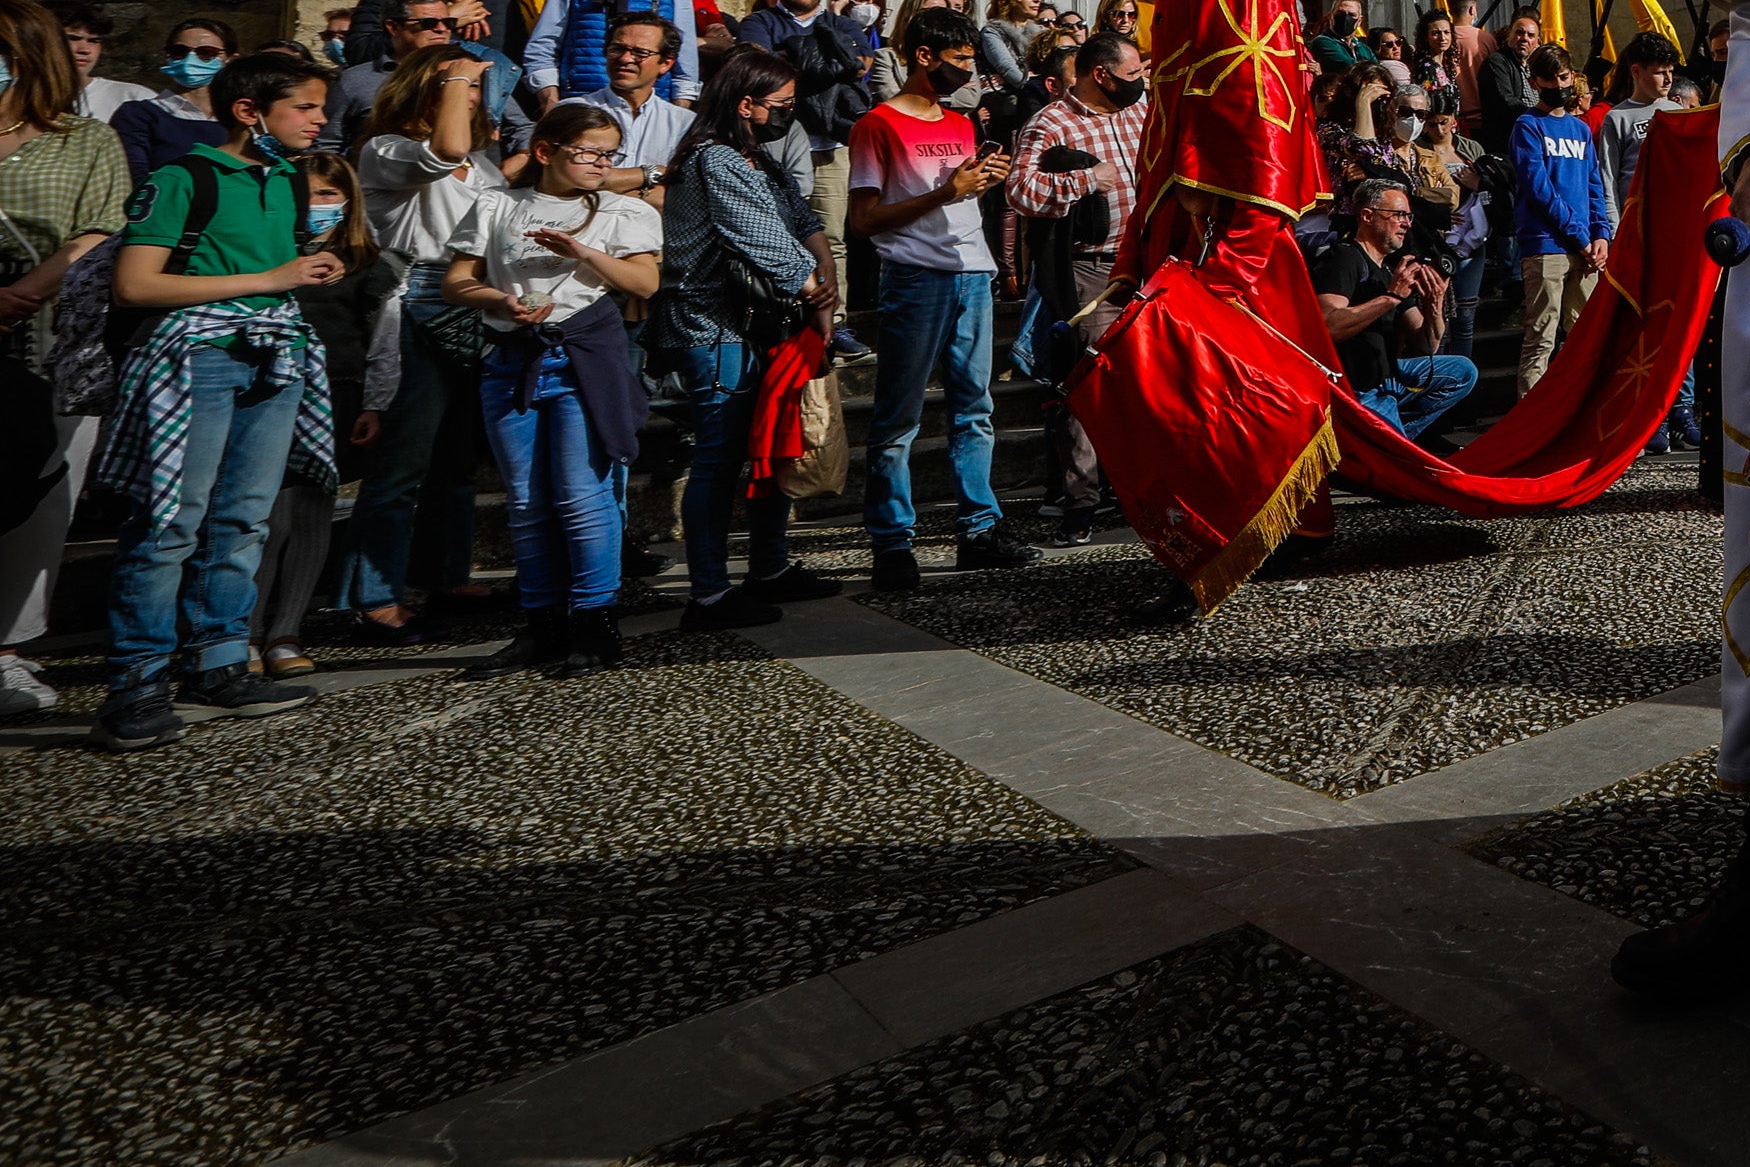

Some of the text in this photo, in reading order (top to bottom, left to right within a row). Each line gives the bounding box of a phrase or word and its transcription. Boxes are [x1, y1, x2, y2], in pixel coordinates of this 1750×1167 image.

[915, 143, 964, 156] SIKSILK
[1544, 136, 1586, 160] RAW
[522, 210, 543, 229] You
